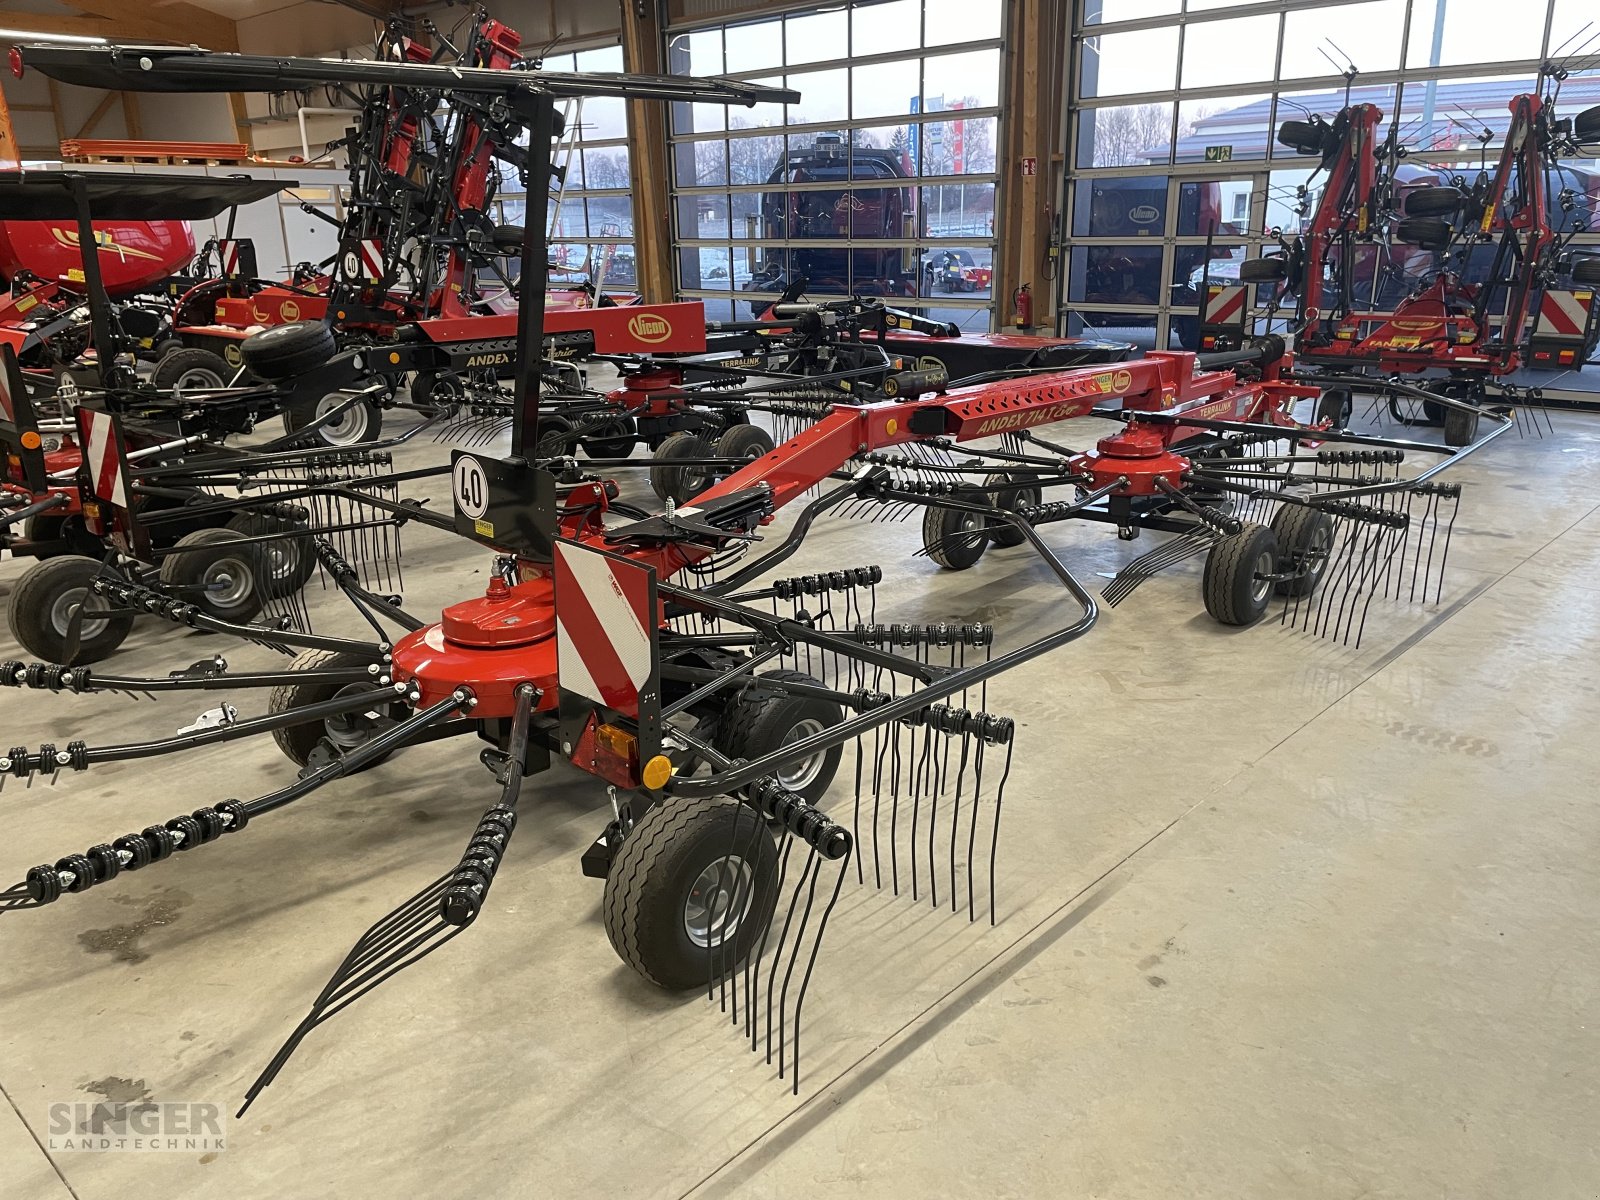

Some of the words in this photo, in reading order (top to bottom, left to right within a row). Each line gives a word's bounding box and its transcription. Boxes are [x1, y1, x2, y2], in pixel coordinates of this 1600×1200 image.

[347, 257, 356, 273] 40
[632, 315, 666, 337] Vicon
[466, 353, 509, 367] ANDEX
[720, 357, 760, 368] TERRALINK
[1200, 400, 1233, 417] TERRALINK
[976, 412, 1025, 435] ANDEX
[1025, 408, 1048, 425] 714
[461, 466, 482, 509] 40
